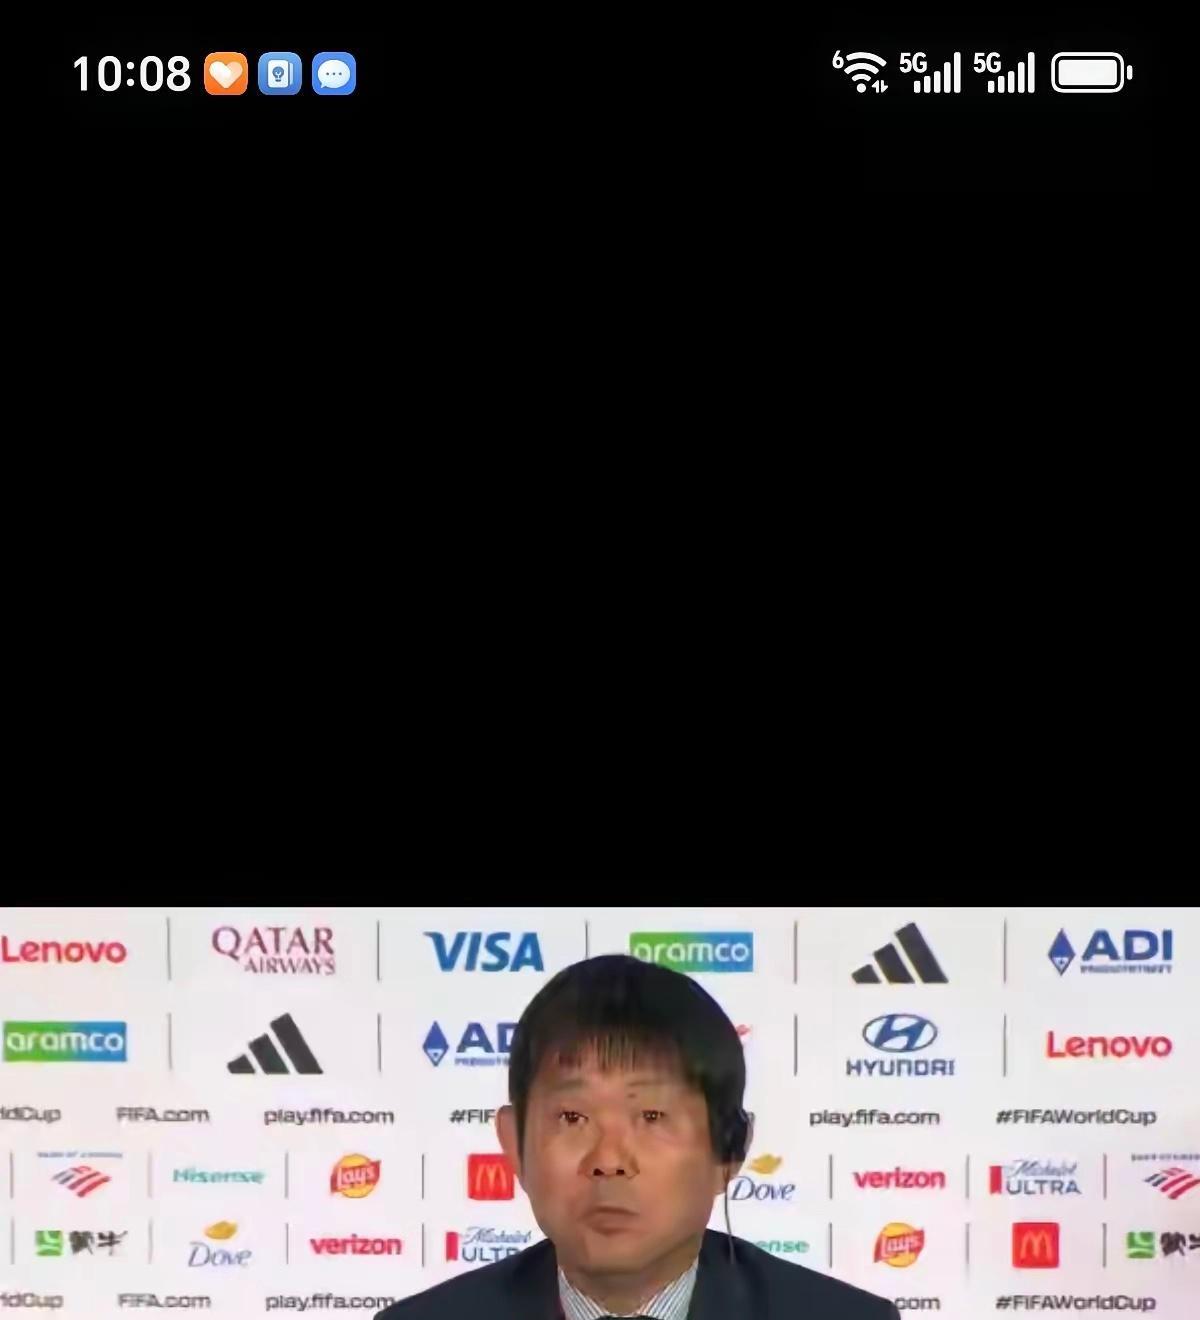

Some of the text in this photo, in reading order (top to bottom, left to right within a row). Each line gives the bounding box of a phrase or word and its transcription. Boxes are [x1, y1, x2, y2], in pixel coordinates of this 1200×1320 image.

[1, 936, 127, 964] Lenovo
[211, 926, 336, 961] QATAR
[425, 932, 544, 972] VISA
[634, 942, 750, 963] aramco
[1082, 930, 1172, 961] ADI
[243, 956, 336, 976] AIRWAYS
[6, 1030, 124, 1054] aramco
[456, 1022, 519, 1053] AD
[1046, 1031, 1172, 1058] Lenovo
[846, 1059, 954, 1076] HYUNDAI
[116, 1107, 210, 1122] FIFA.com
[264, 1108, 394, 1125] play.fifa.com
[450, 1109, 496, 1123] #FIF
[810, 1109, 940, 1128] play.fifa.com
[996, 1109, 1157, 1126] #FIFAWorldCup
[173, 1168, 264, 1184] Hisense
[853, 1167, 945, 1189] verizon
[730, 1174, 795, 1200] Dove
[1006, 1179, 1081, 1195] ULTRA
[188, 1240, 252, 1267] Dove
[310, 1234, 402, 1255] verizon
[756, 1240, 812, 1254] ense
[118, 1293, 211, 1308] FIFA.com
[265, 1293, 395, 1311] play.fifa.com
[996, 1295, 1156, 1312] #FIFAWorldCup
